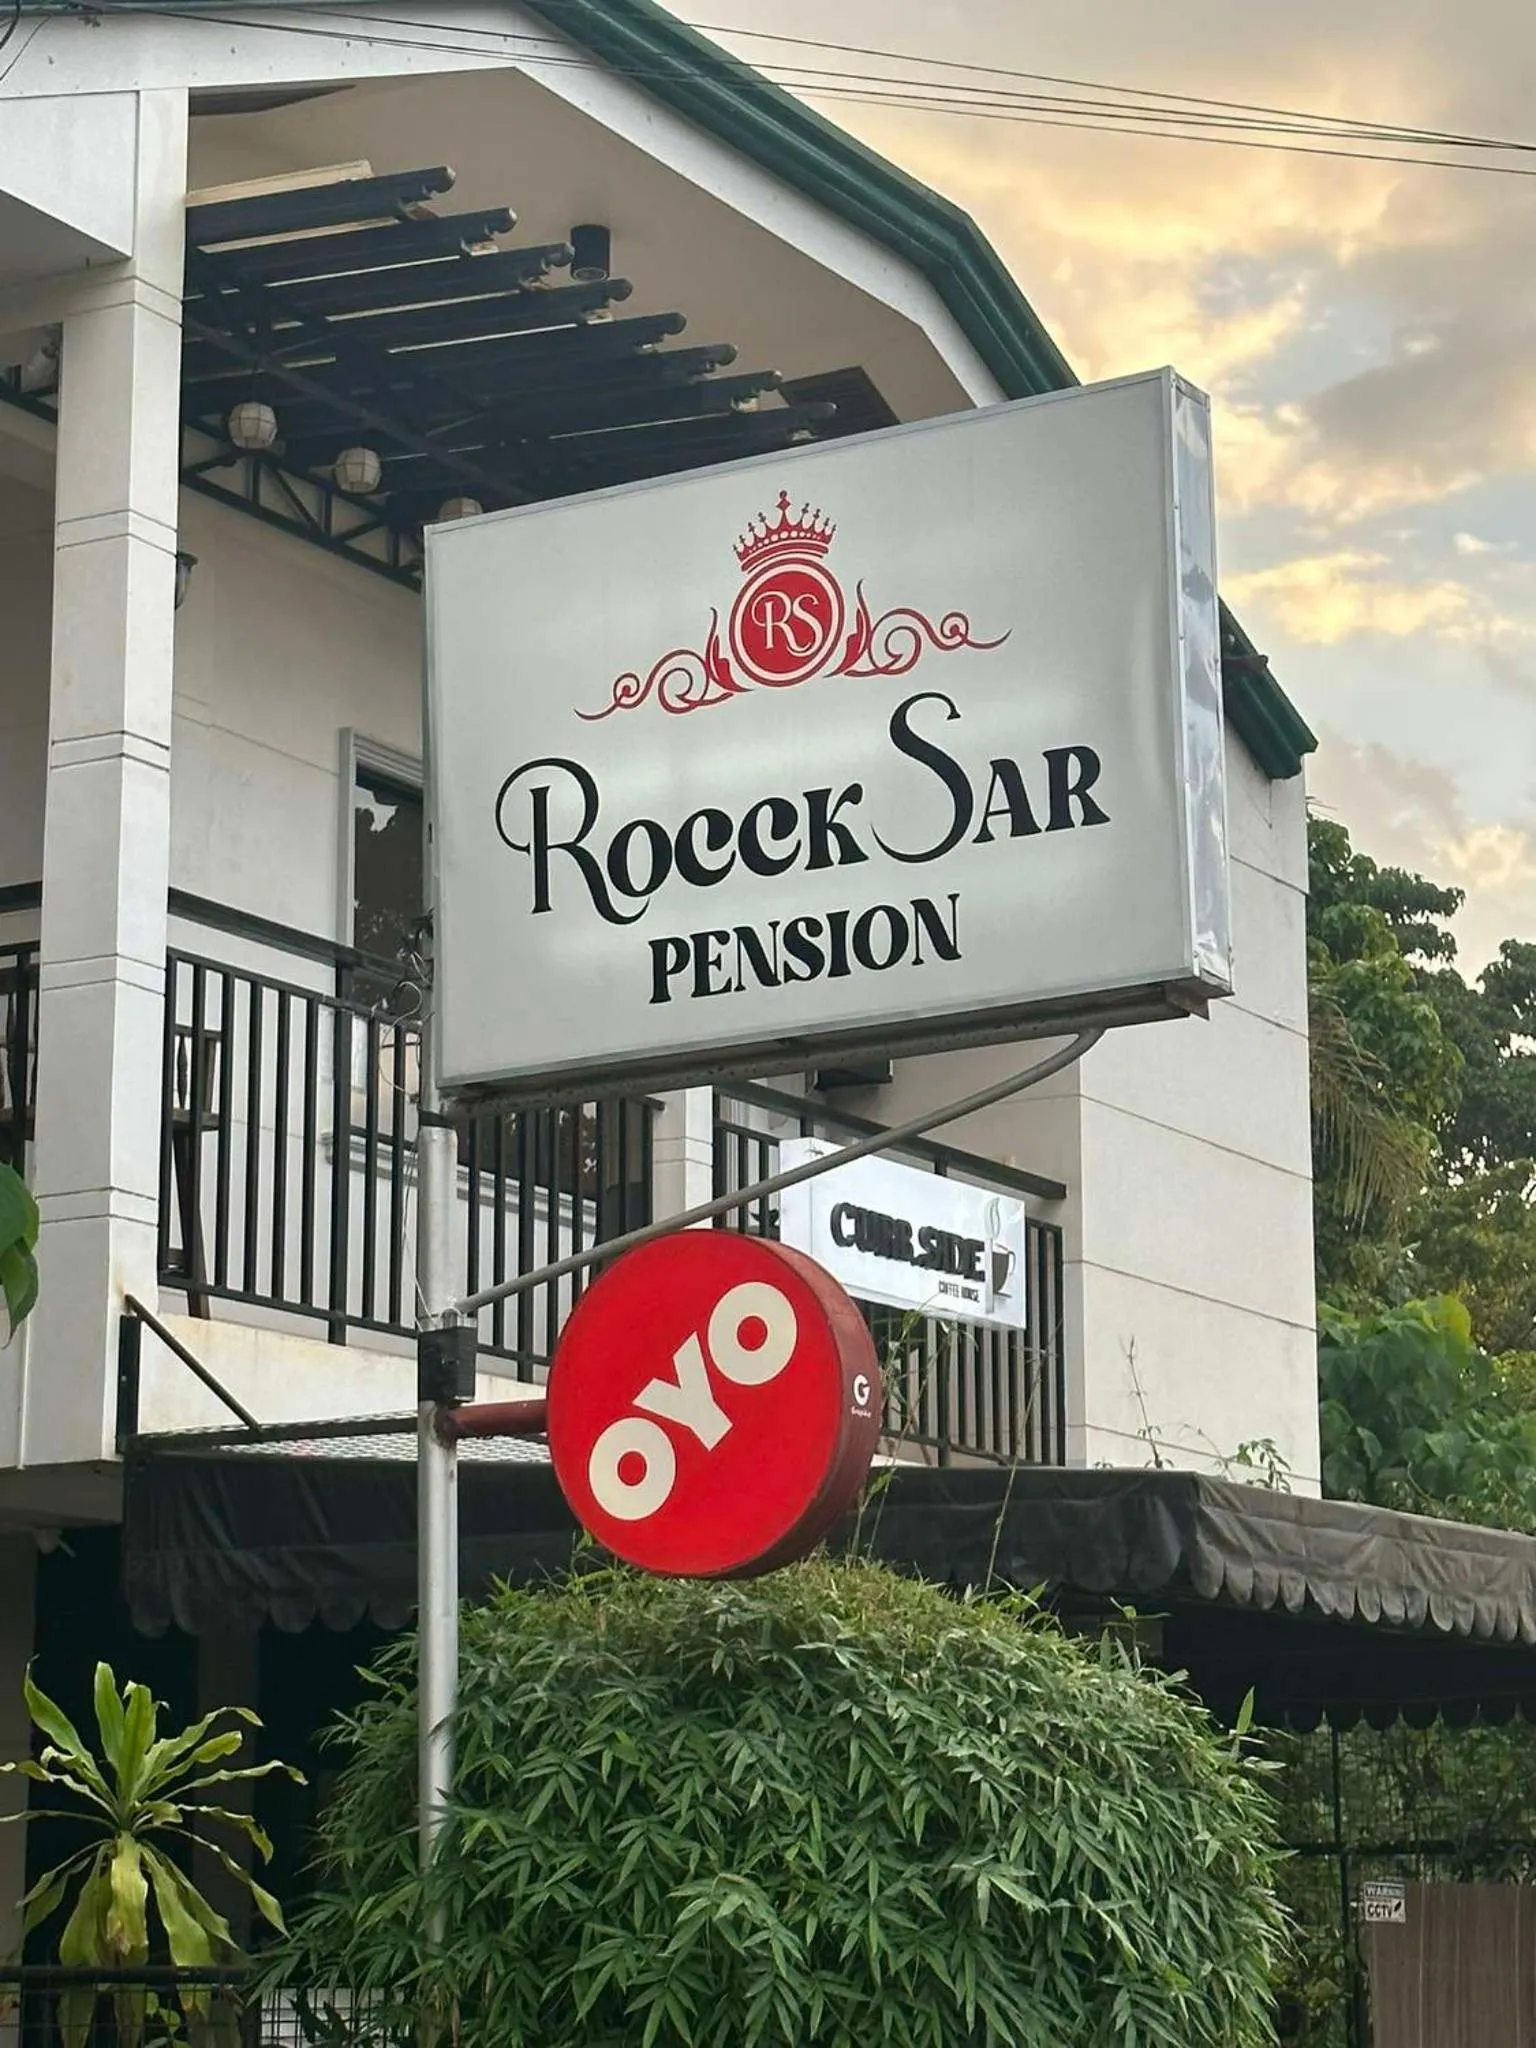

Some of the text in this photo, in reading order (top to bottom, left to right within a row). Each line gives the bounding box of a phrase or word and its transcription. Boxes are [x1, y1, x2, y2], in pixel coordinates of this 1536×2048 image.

[751, 590, 823, 657] RS
[871, 692, 1111, 864] SAR
[648, 893, 962, 1004] PENSION
[830, 1202, 985, 1282] CURB SIDE
[588, 1281, 798, 1521] OYO
[1367, 1903, 1392, 1918] CCTV
